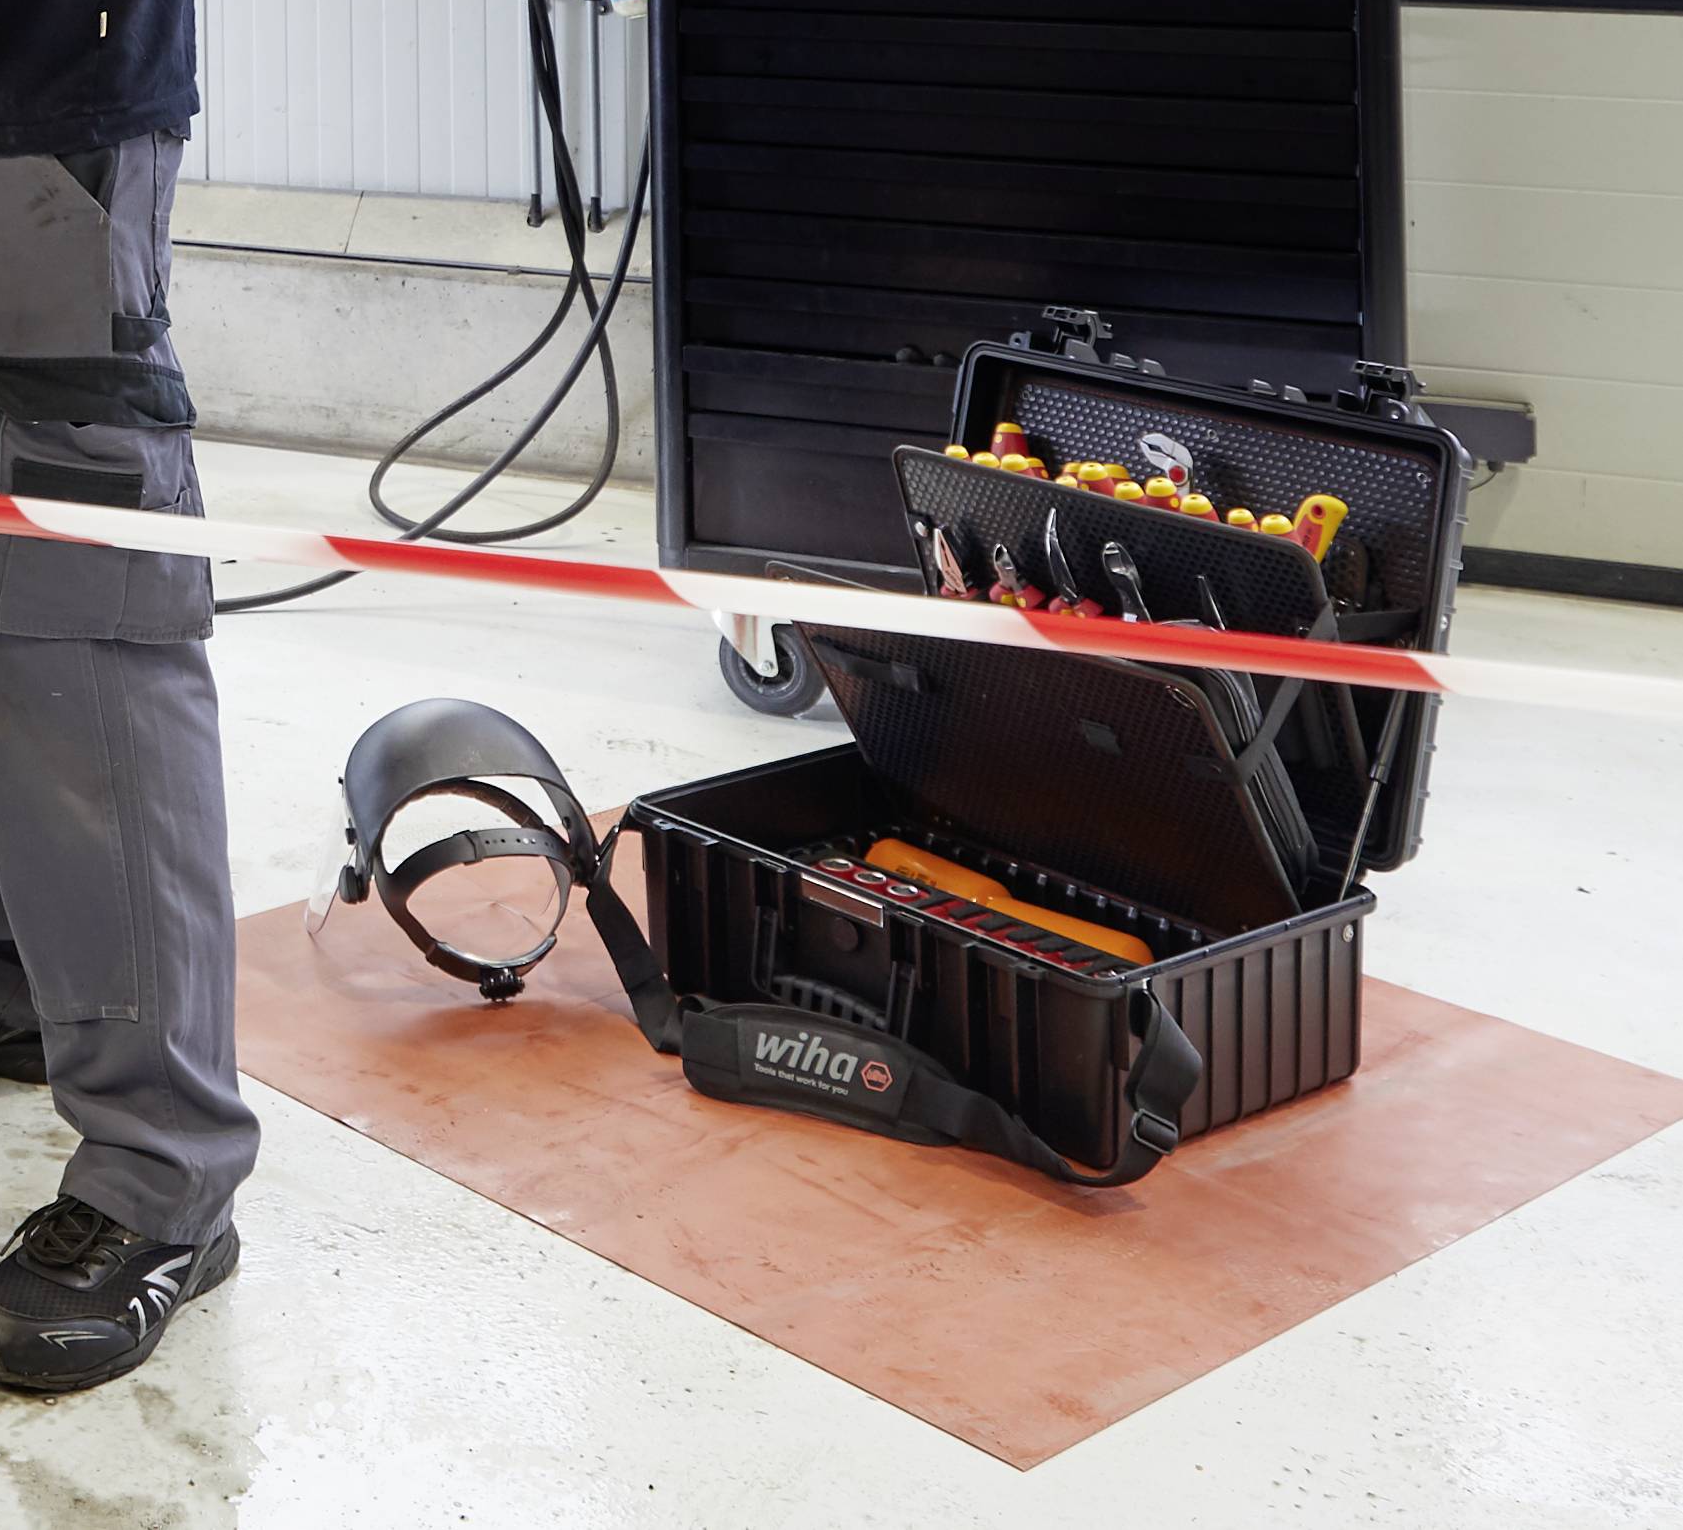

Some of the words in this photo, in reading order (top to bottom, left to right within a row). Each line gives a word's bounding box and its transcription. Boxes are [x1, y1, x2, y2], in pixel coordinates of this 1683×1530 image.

[755, 1031, 858, 1083] wiha
[754, 1062, 777, 1077] Tools
[777, 1070, 795, 1082] that
[795, 1076, 817, 1088] work
[818, 1079, 833, 1091] for
[832, 1086, 849, 1097] you
